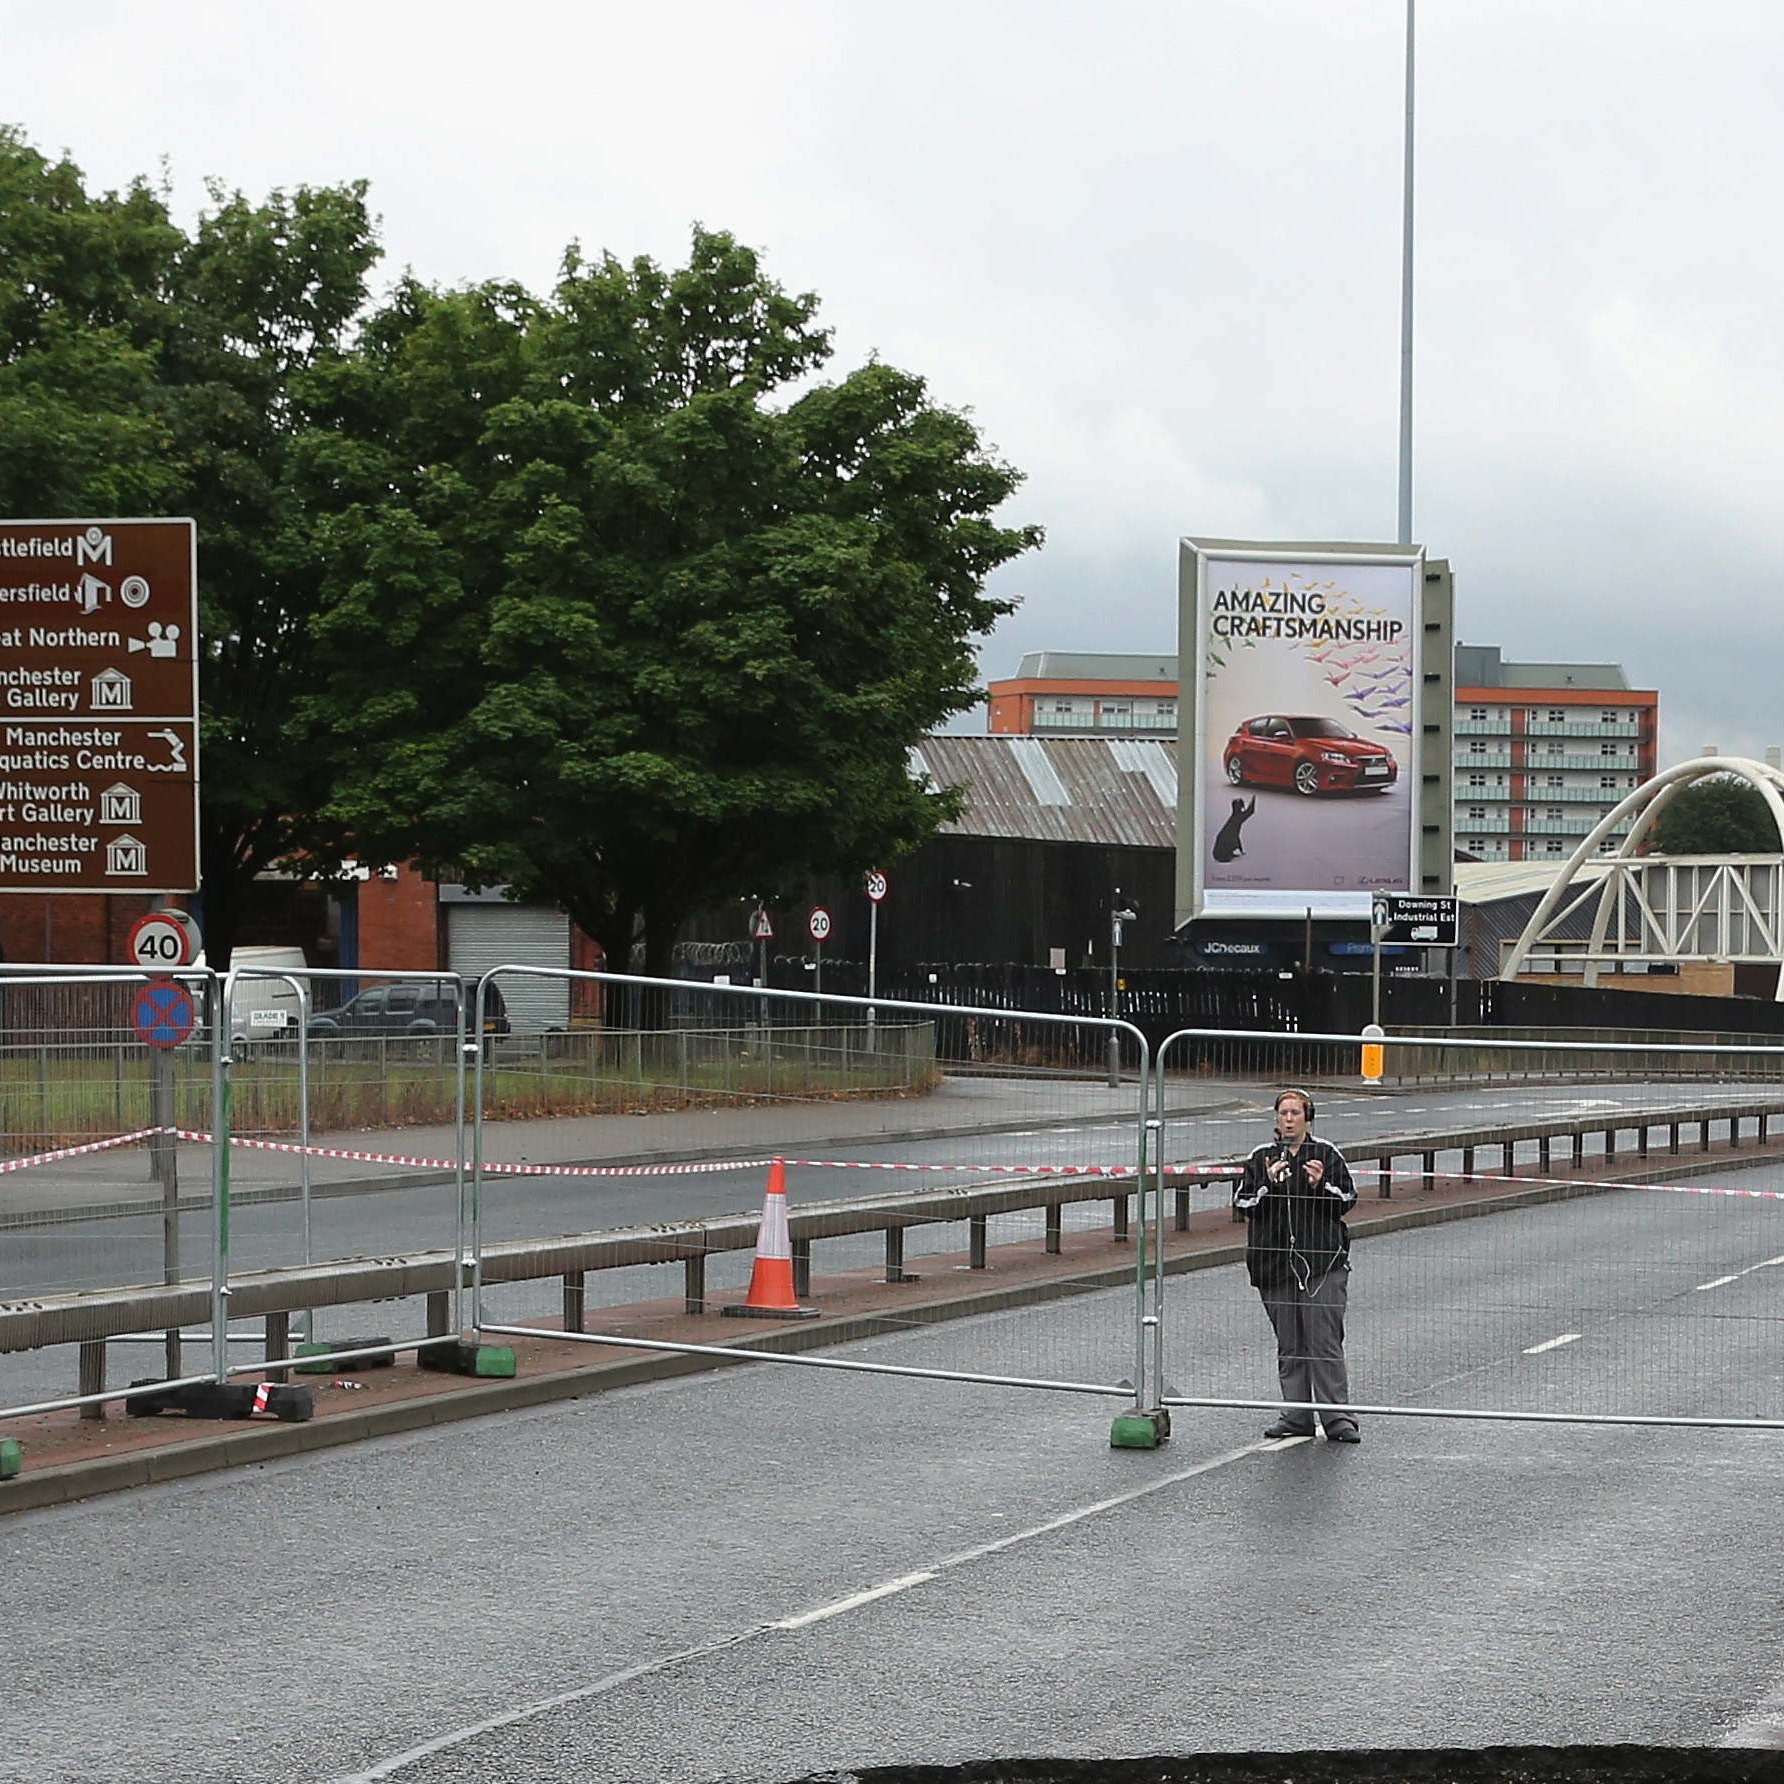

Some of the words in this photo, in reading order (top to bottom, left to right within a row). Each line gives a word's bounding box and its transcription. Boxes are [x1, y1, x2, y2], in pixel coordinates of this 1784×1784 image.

[1213, 590, 1327, 614] AMAZING
[29, 627, 119, 647] Northern
[1212, 615, 1403, 642] CRAFTSMANSHIP
[7, 687, 79, 711] Gallery
[6, 727, 121, 746] Manchester
[77, 750, 144, 769] Centre
[22, 803, 94, 825] Gallery
[0, 853, 81, 872] Museum
[871, 880, 884, 893] 20
[1398, 899, 1437, 911] Downing
[1441, 900, 1451, 910] St
[812, 918, 828, 931] 20
[1393, 911, 1437, 922] Industrial
[1440, 912, 1455, 922] Est
[138, 935, 179, 959] 40
